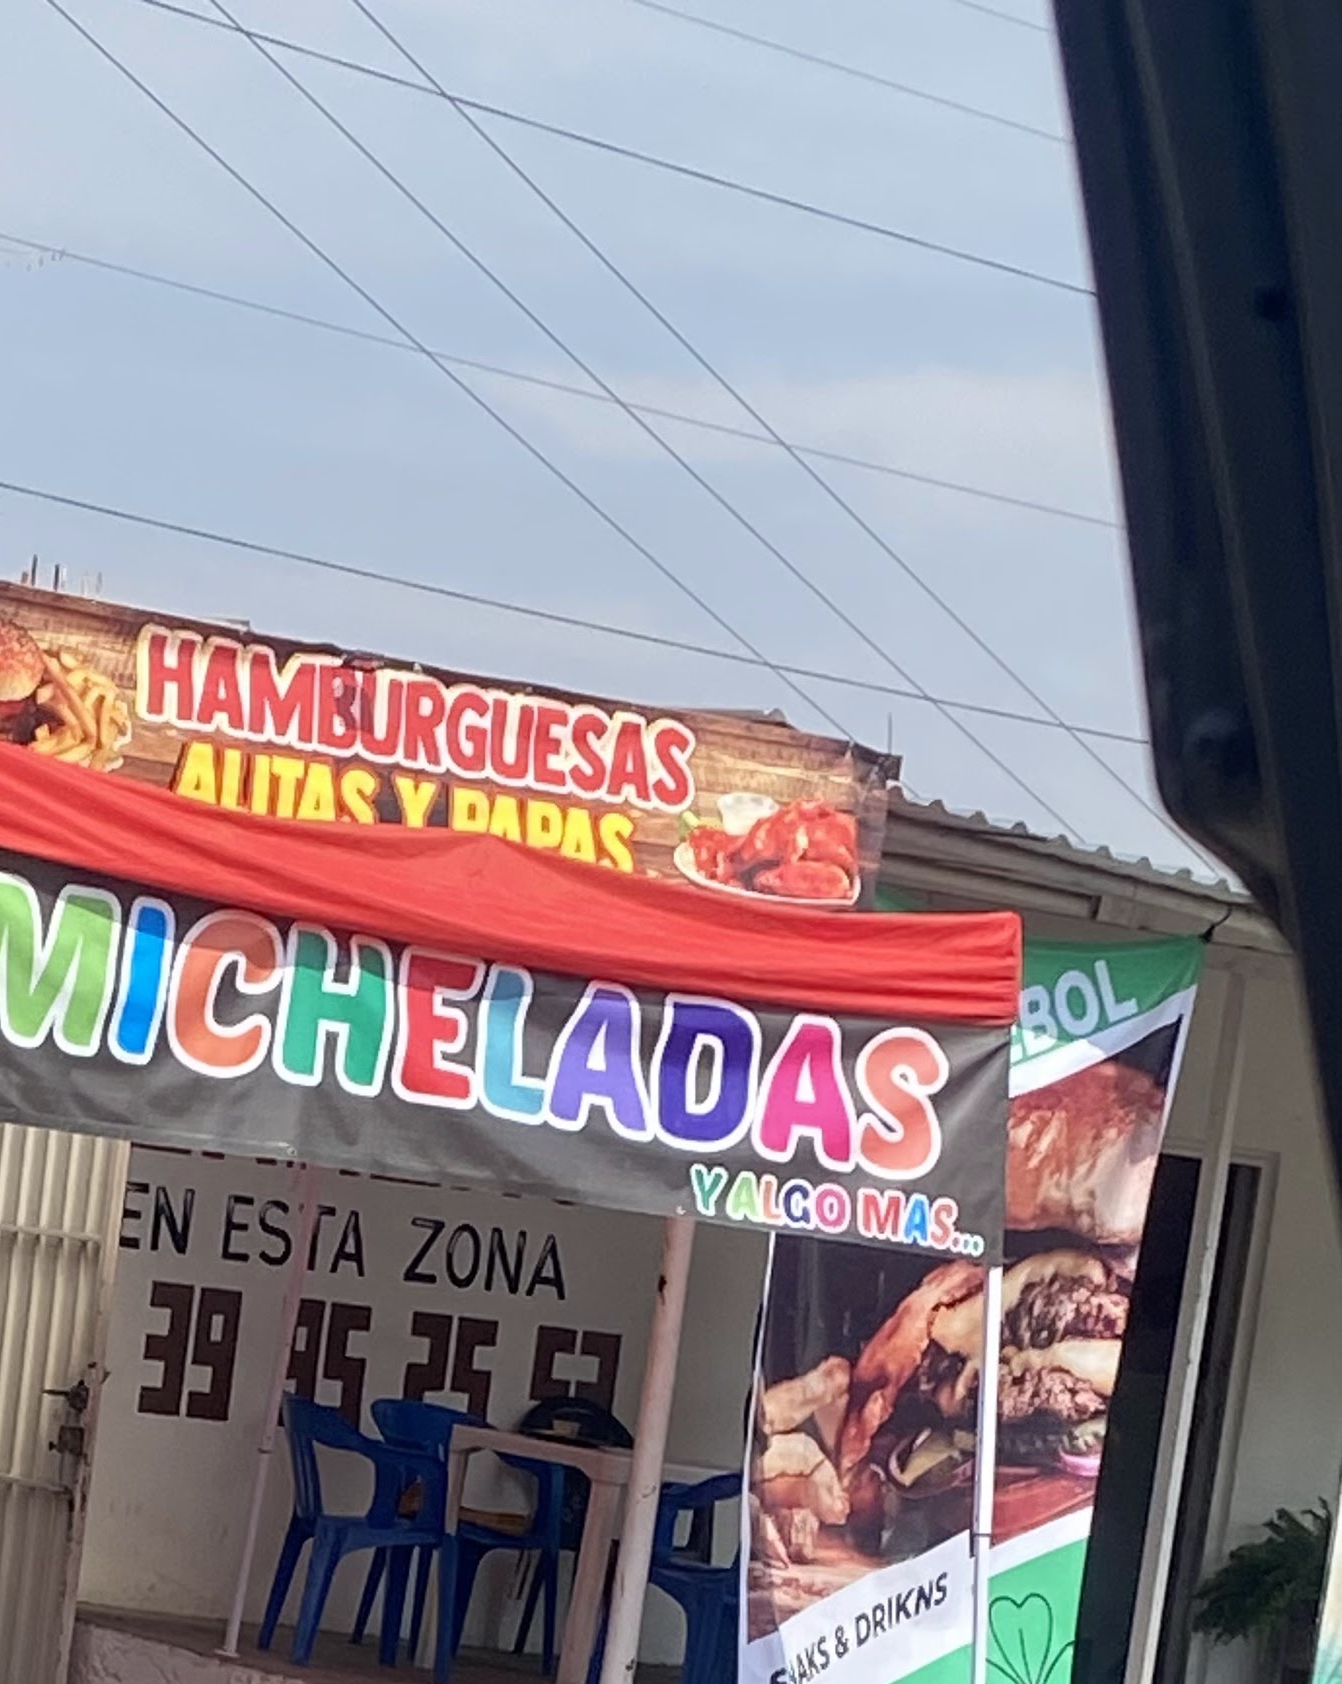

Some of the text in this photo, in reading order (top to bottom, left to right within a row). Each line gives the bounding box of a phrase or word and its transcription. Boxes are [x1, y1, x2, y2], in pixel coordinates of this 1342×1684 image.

[137, 624, 696, 813] HAMBURGUESAS
[172, 741, 635, 874] ALITAS Y PAPAS
[1011, 960, 1139, 1064] BOL
[119, 1181, 567, 1300] EN ESTA ZONA
[138, 1280, 243, 1422] 39
[834, 1625, 850, 1659] &
[855, 1571, 948, 1648] DRIKNS
